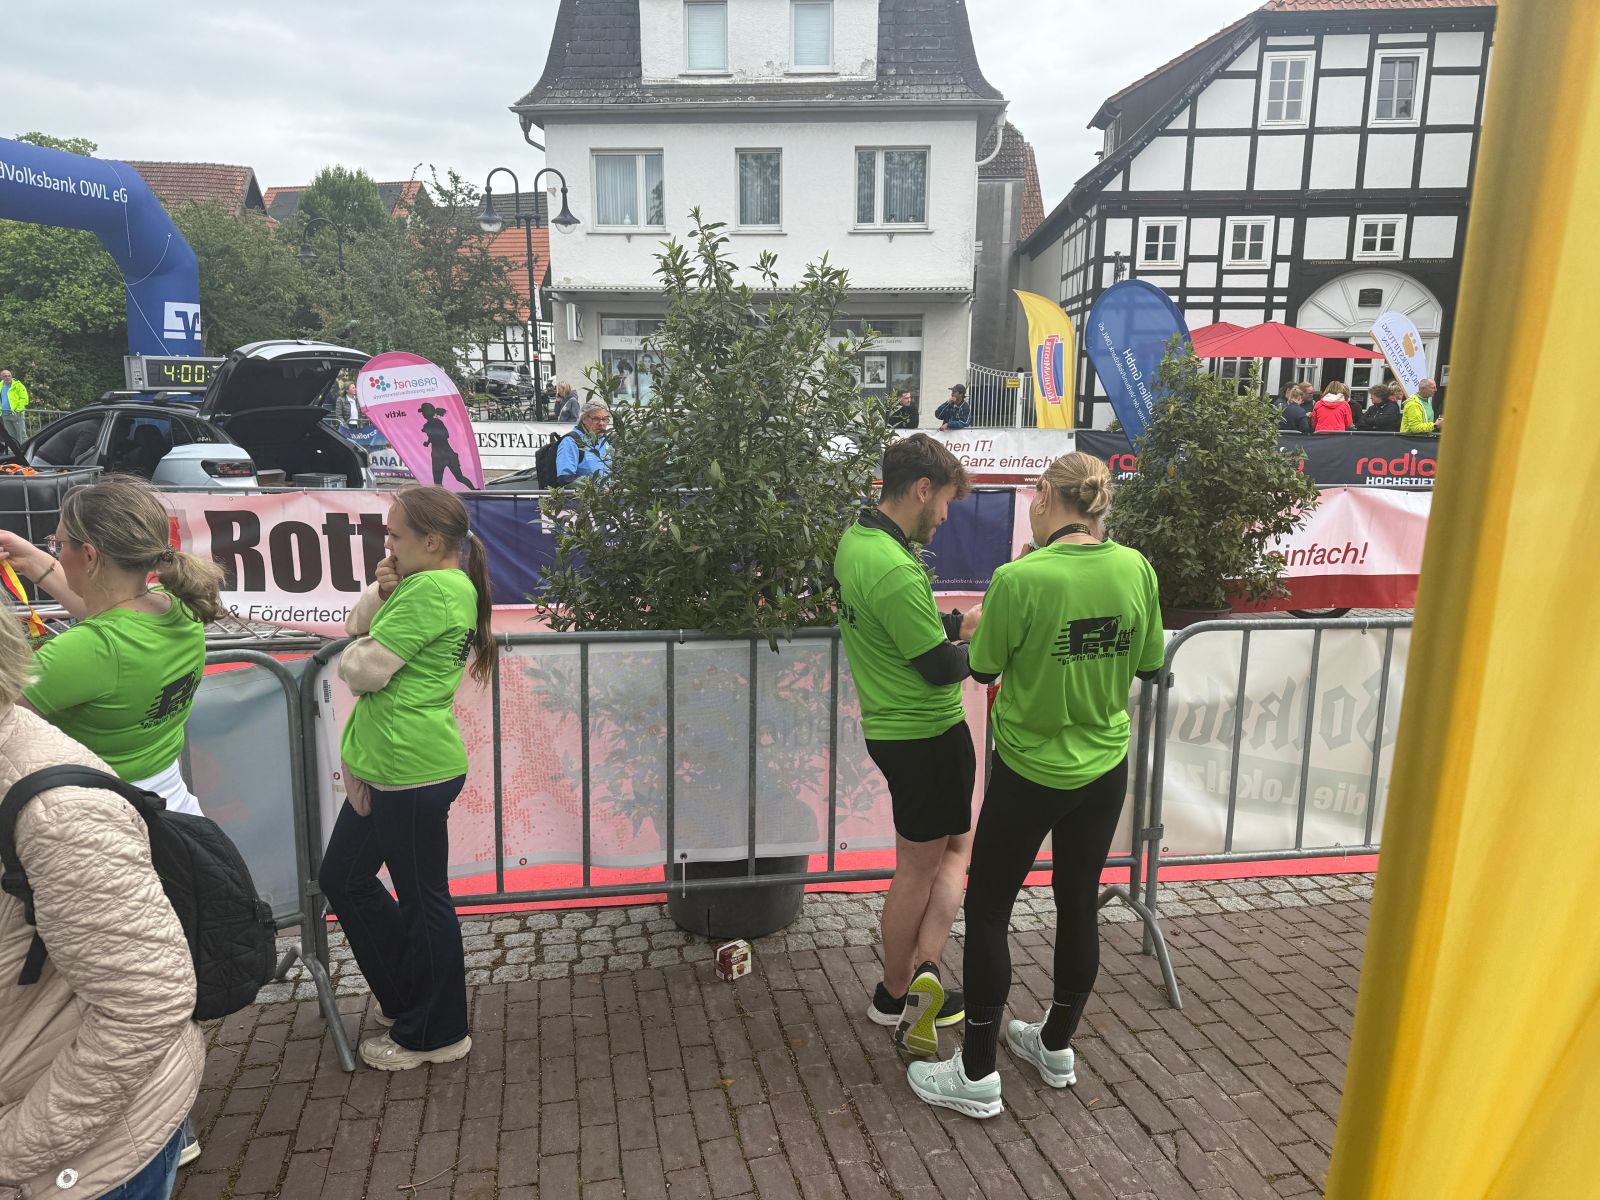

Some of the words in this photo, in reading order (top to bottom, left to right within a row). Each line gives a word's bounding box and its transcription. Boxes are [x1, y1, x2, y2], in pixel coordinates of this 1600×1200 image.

[80, 180, 110, 200] OWL
[113, 188, 128, 203] eG
[474, 432, 552, 448] ESTFALE
[974, 440, 993, 452] IT!
[959, 455, 995, 472] Ganz
[1356, 448, 1438, 477] radio
[204, 510, 390, 593] Rott
[227, 604, 240, 619] &
